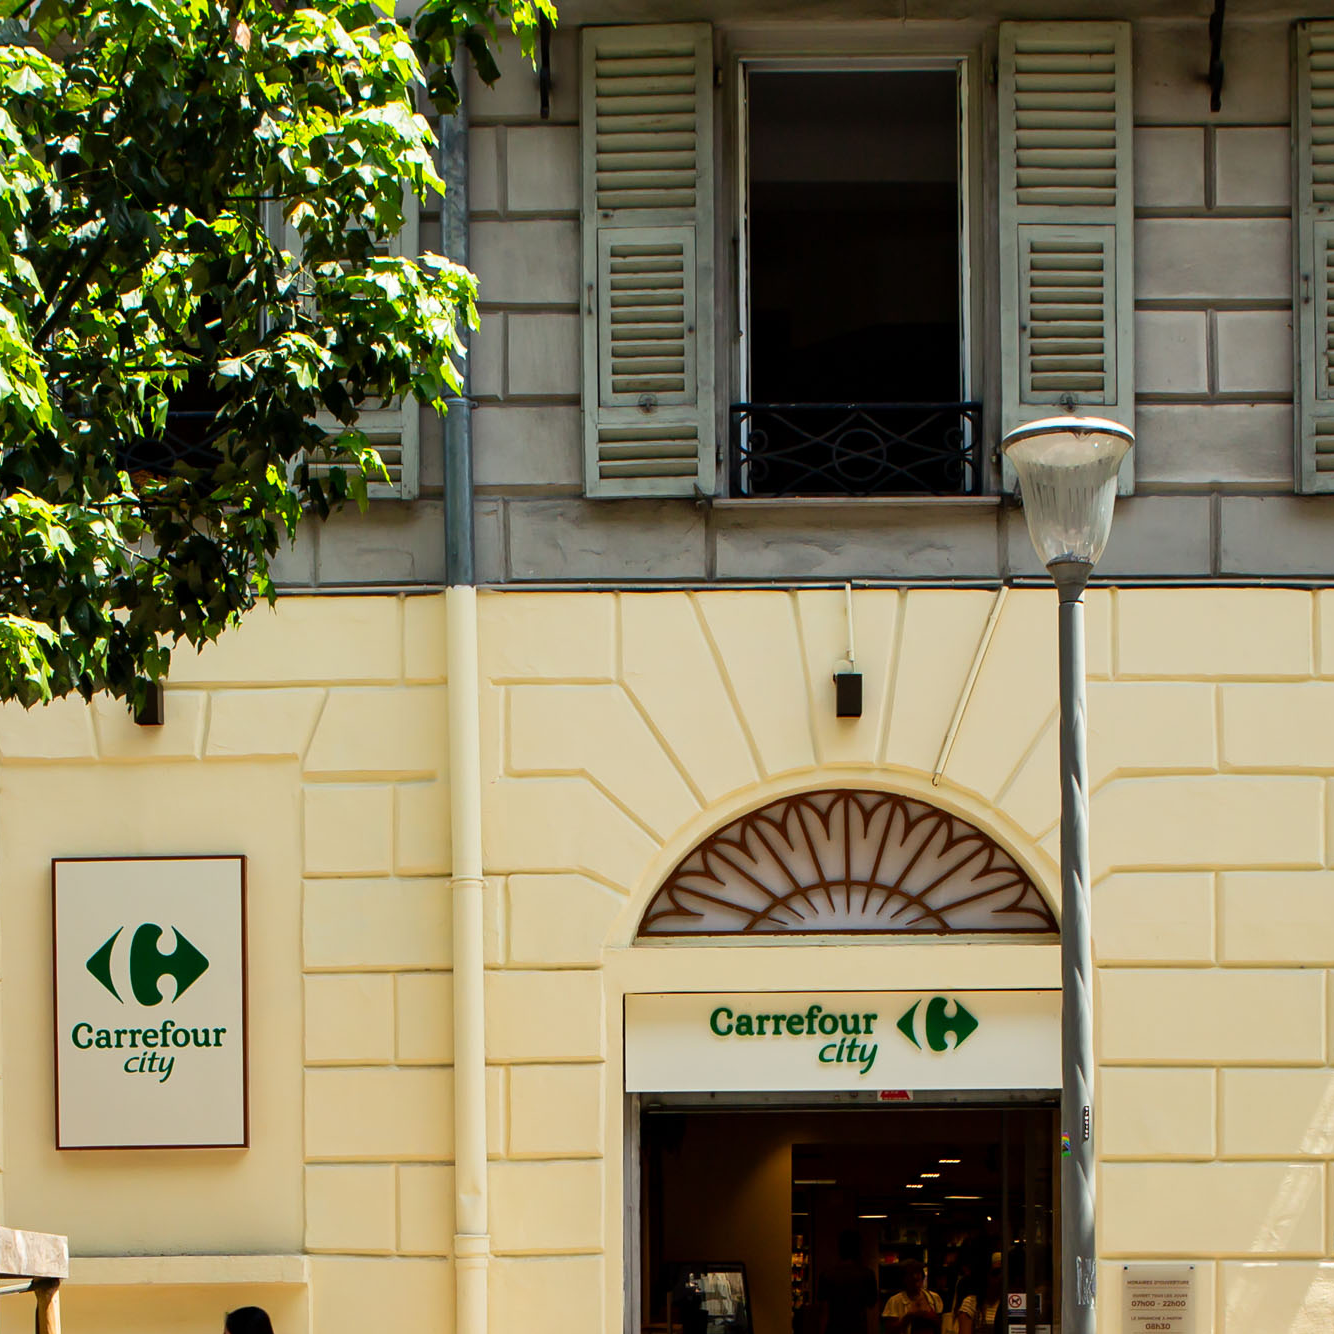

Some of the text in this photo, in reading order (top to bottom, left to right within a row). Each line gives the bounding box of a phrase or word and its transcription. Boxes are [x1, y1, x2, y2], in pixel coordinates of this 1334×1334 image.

[71, 1019, 227, 1050] Carrefour
[709, 1004, 878, 1037] Carrefour
[123, 1051, 175, 1084] city
[818, 1037, 879, 1075] city
